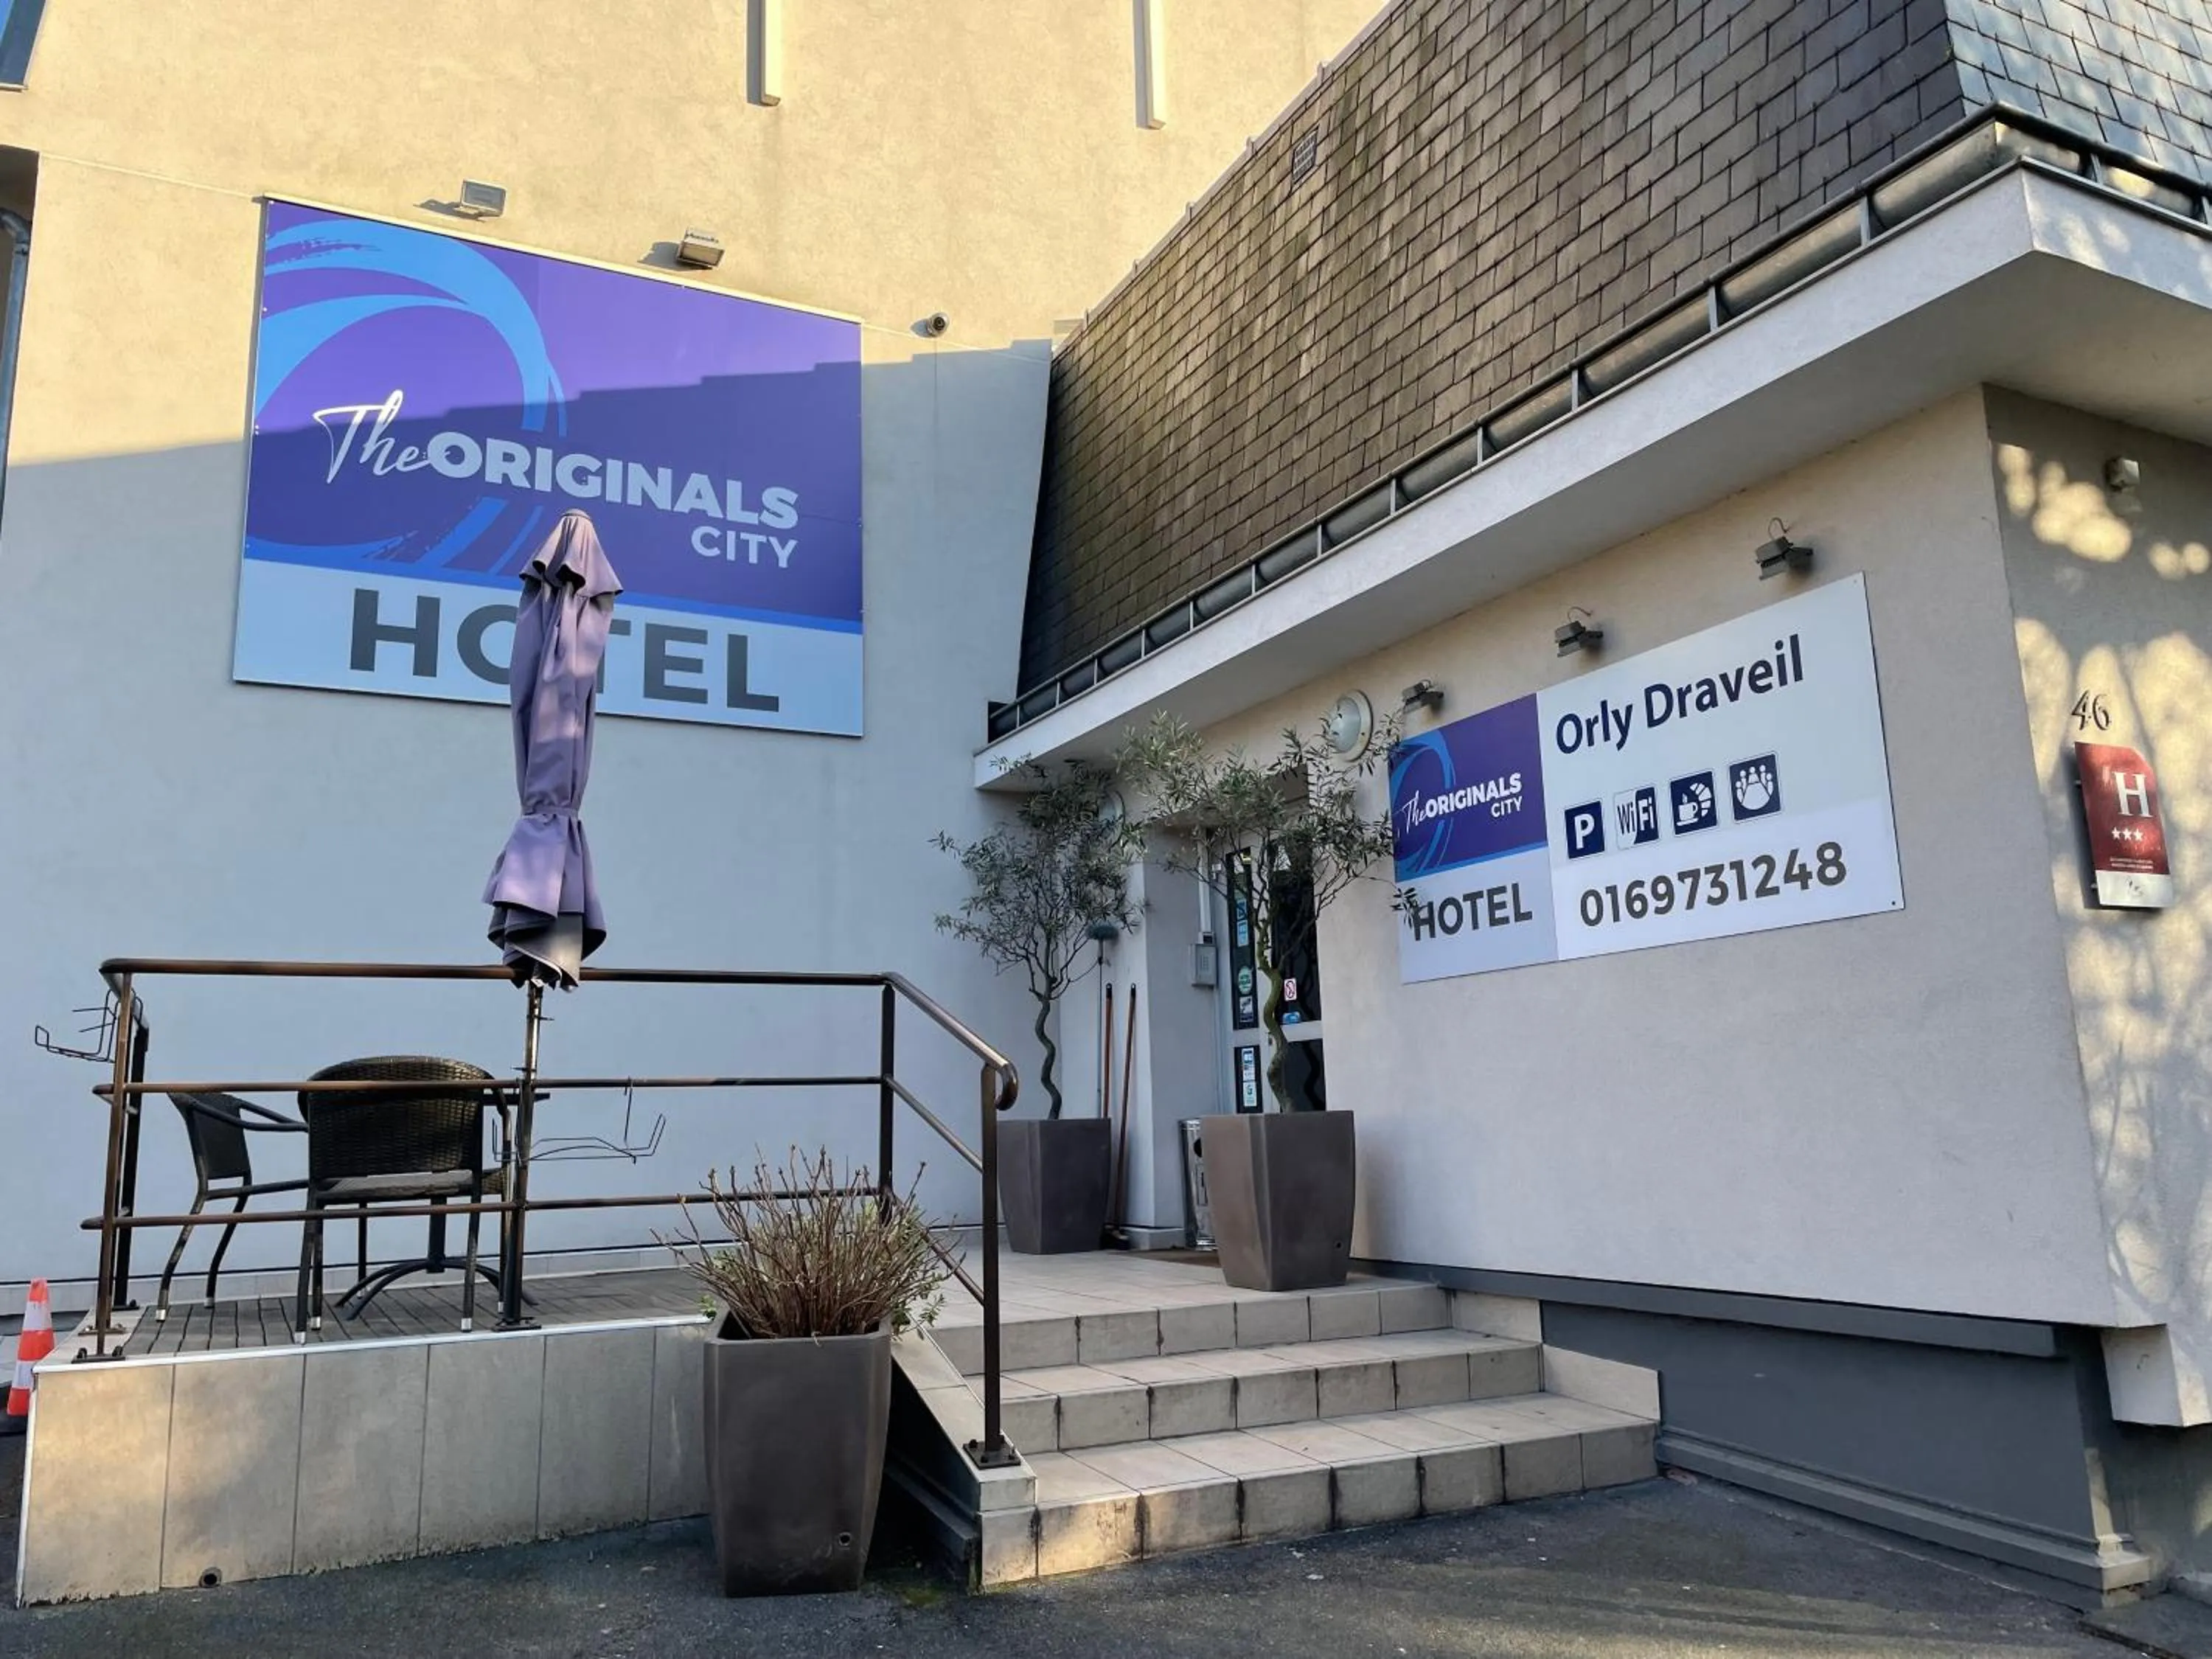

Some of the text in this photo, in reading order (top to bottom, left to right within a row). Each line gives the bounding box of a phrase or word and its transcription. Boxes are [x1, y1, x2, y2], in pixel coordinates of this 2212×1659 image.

[427, 431, 799, 529] ORIGINALS
[692, 524, 799, 569] CITY
[1556, 633, 1804, 755] Orly Draveil
[2070, 689, 2111, 731] 46
[1425, 773, 1523, 818] ORIGINALS
[1491, 796, 1523, 818] CITY
[1617, 796, 1655, 835] WiFi
[2112, 771, 2154, 818] H
[1579, 841, 1846, 928] 0169731248
[1413, 883, 1533, 941] HOTEL
